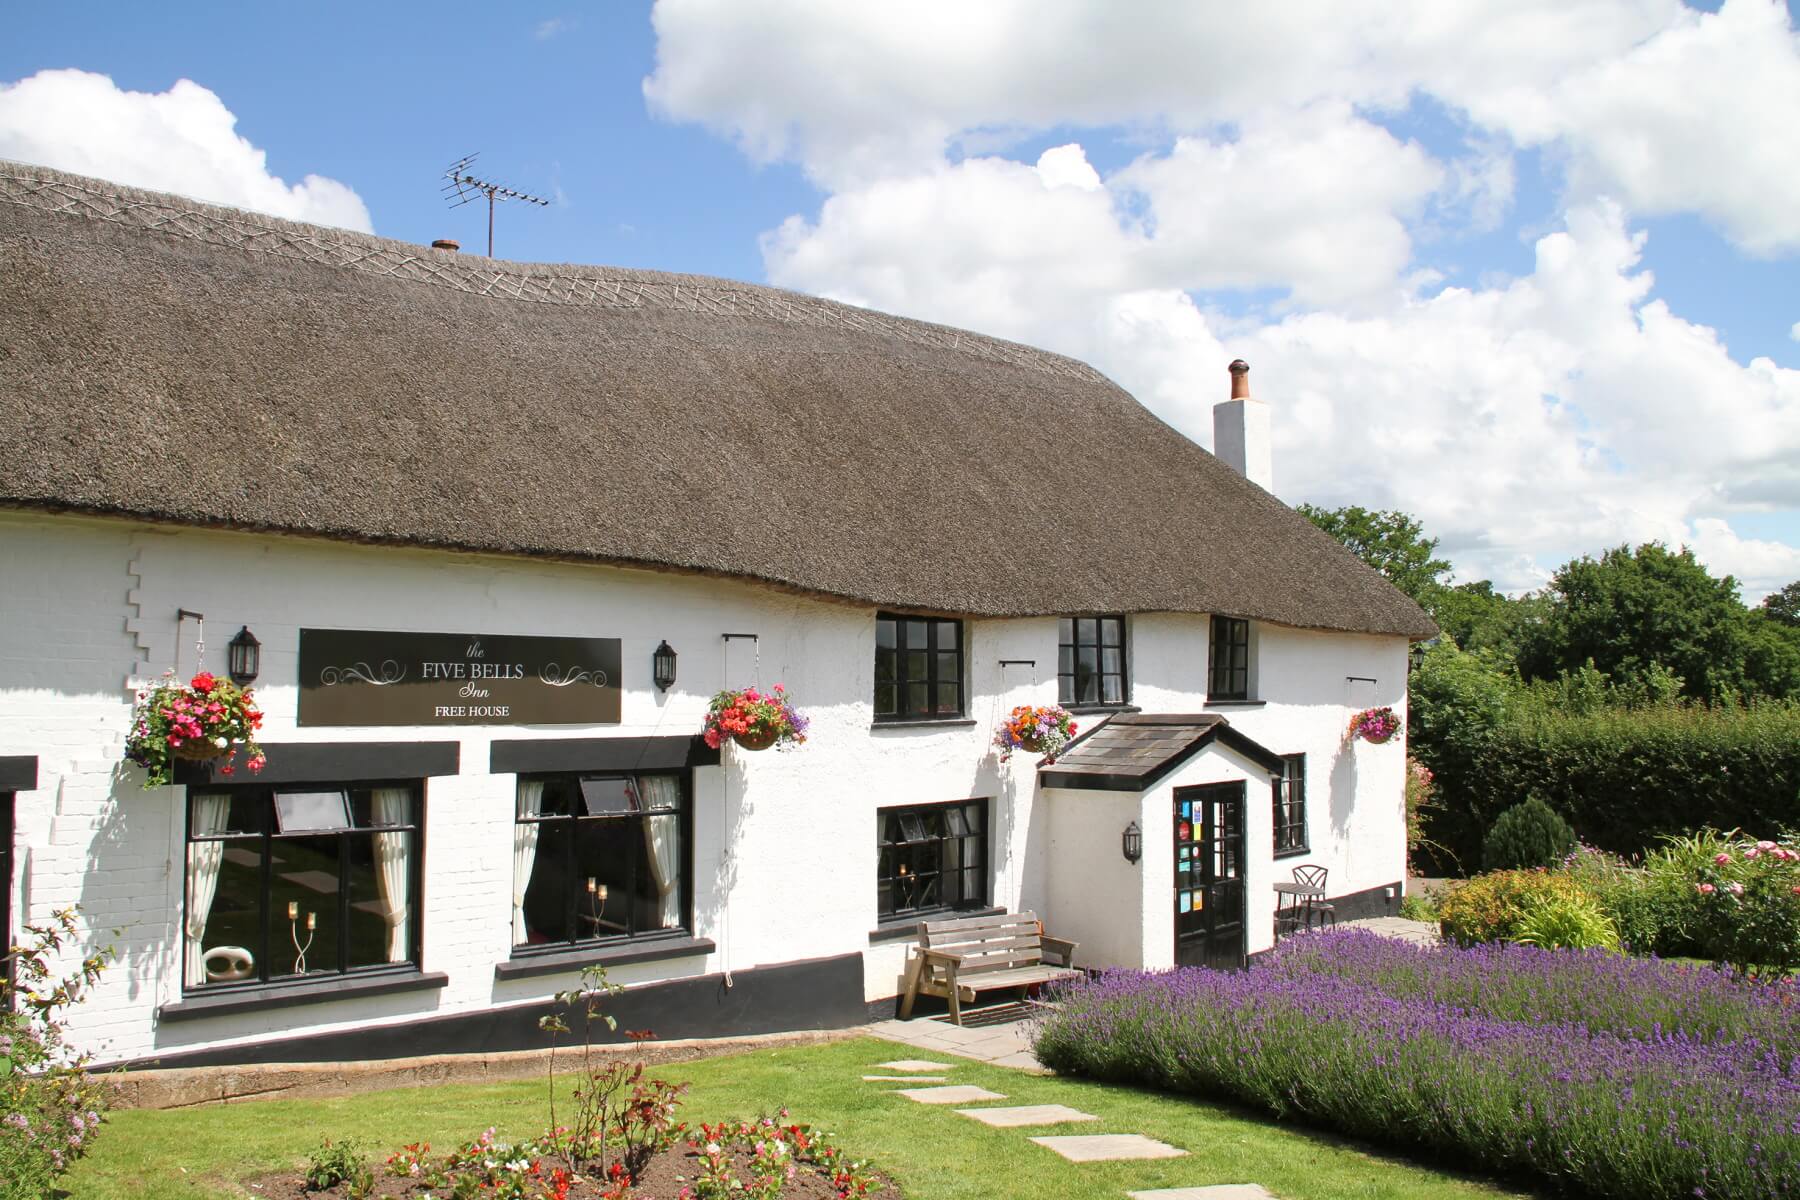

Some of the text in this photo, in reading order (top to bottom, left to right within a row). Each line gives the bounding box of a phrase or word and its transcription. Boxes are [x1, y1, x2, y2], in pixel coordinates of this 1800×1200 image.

[466, 641, 485, 658] the
[422, 662, 524, 680] FIVE BELLS
[459, 681, 490, 698] Inn
[435, 706, 510, 717] FREE HOUSE
